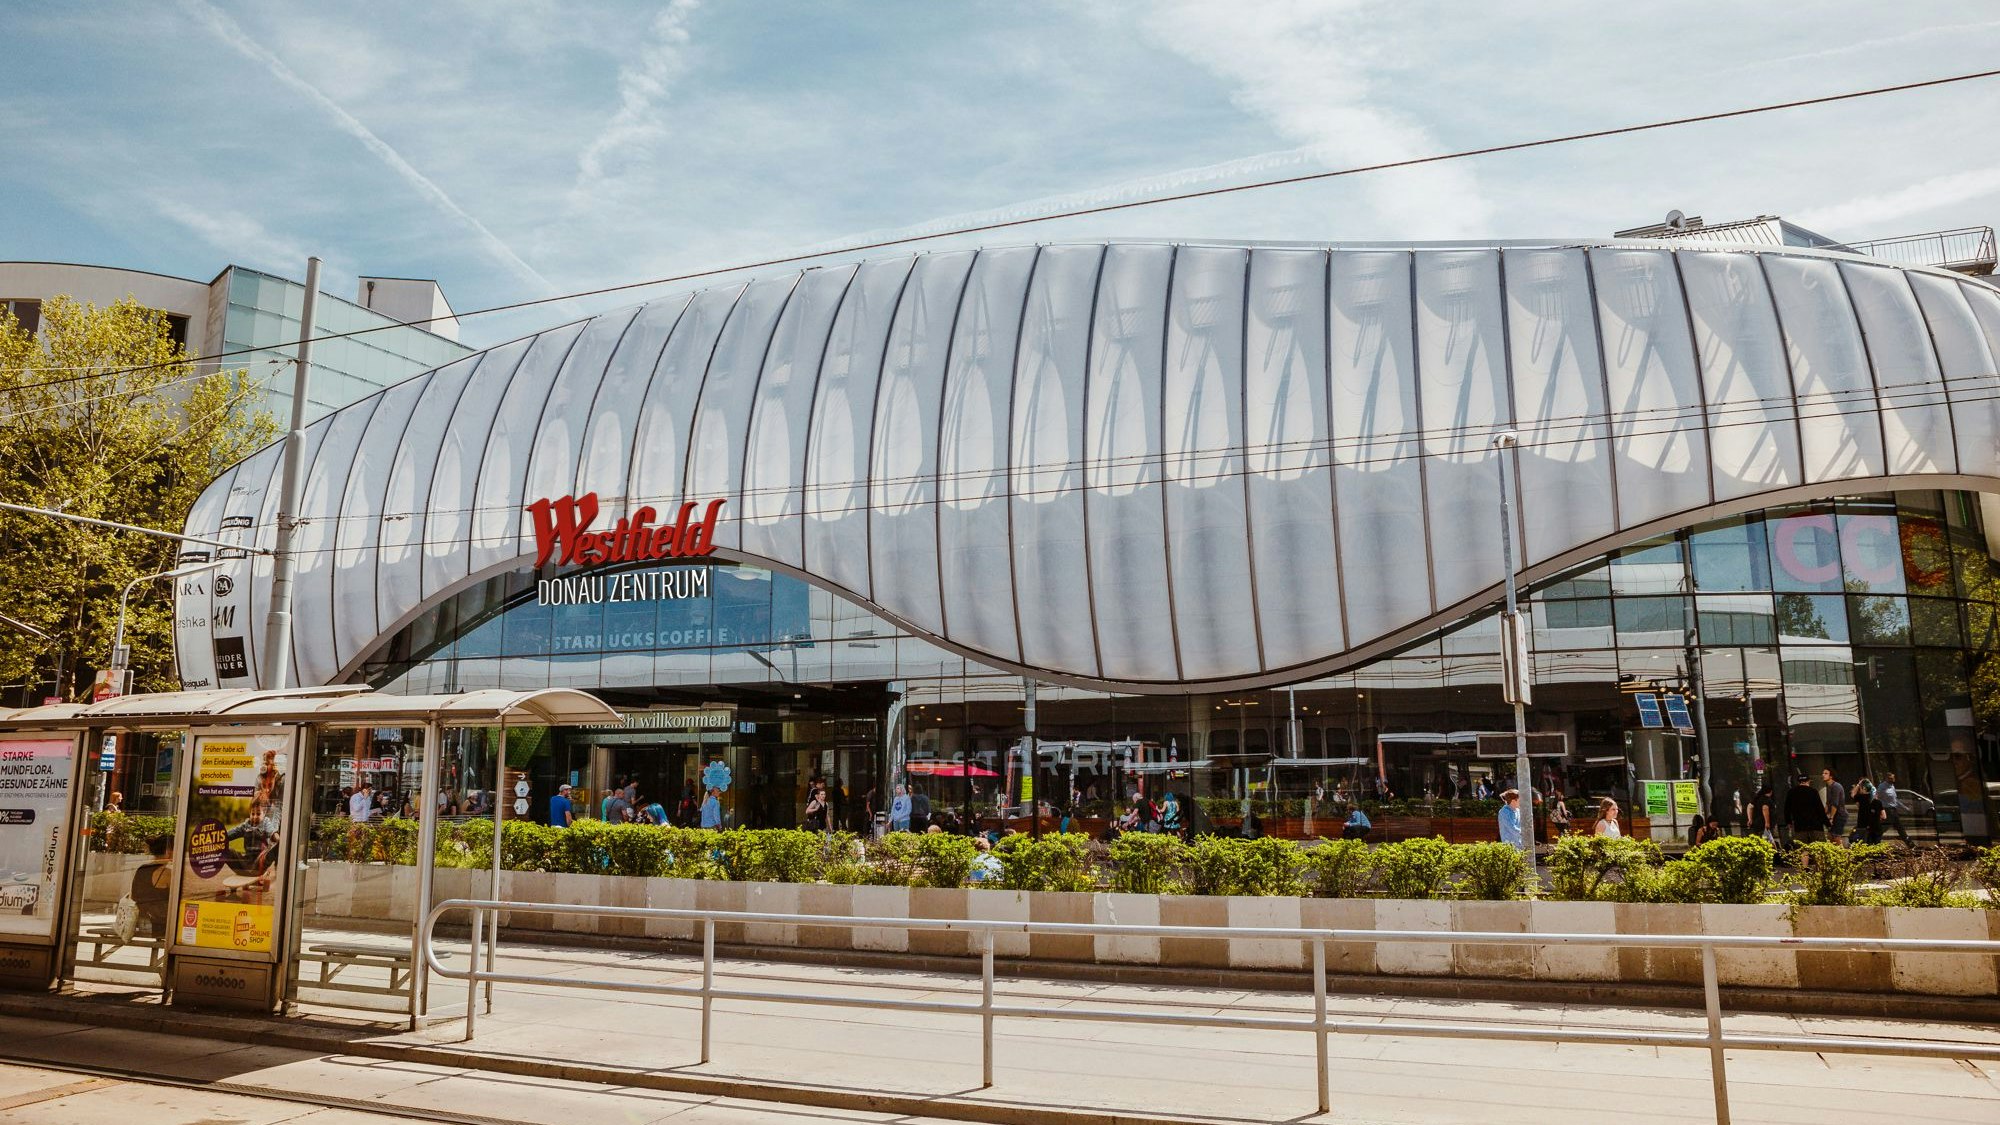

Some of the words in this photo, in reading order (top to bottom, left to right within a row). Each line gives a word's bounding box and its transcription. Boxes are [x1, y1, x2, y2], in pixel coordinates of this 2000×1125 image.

[525, 492, 727, 569] Westfield
[538, 577, 604, 606] DONAU
[609, 569, 707, 603] ZENTRUM
[554, 632, 654, 650] STARUCKS
[660, 628, 728, 645] COFFE
[640, 712, 727, 729] willkommen
[204, 745, 222, 753] Früher
[222, 745, 235, 753] habe
[3, 751, 34, 761] STARKE
[1, 764, 54, 775] MUNDFLORA.
[201, 772, 231, 780] geschoben.
[0, 779, 38, 789] GESUNDE
[39, 777, 68, 789] ZÄHNE
[201, 823, 215, 832] JETZT
[191, 830, 226, 846] GRATIS
[46, 826, 59, 882] zendium
[191, 843, 225, 855] ZUSTELLUNG
